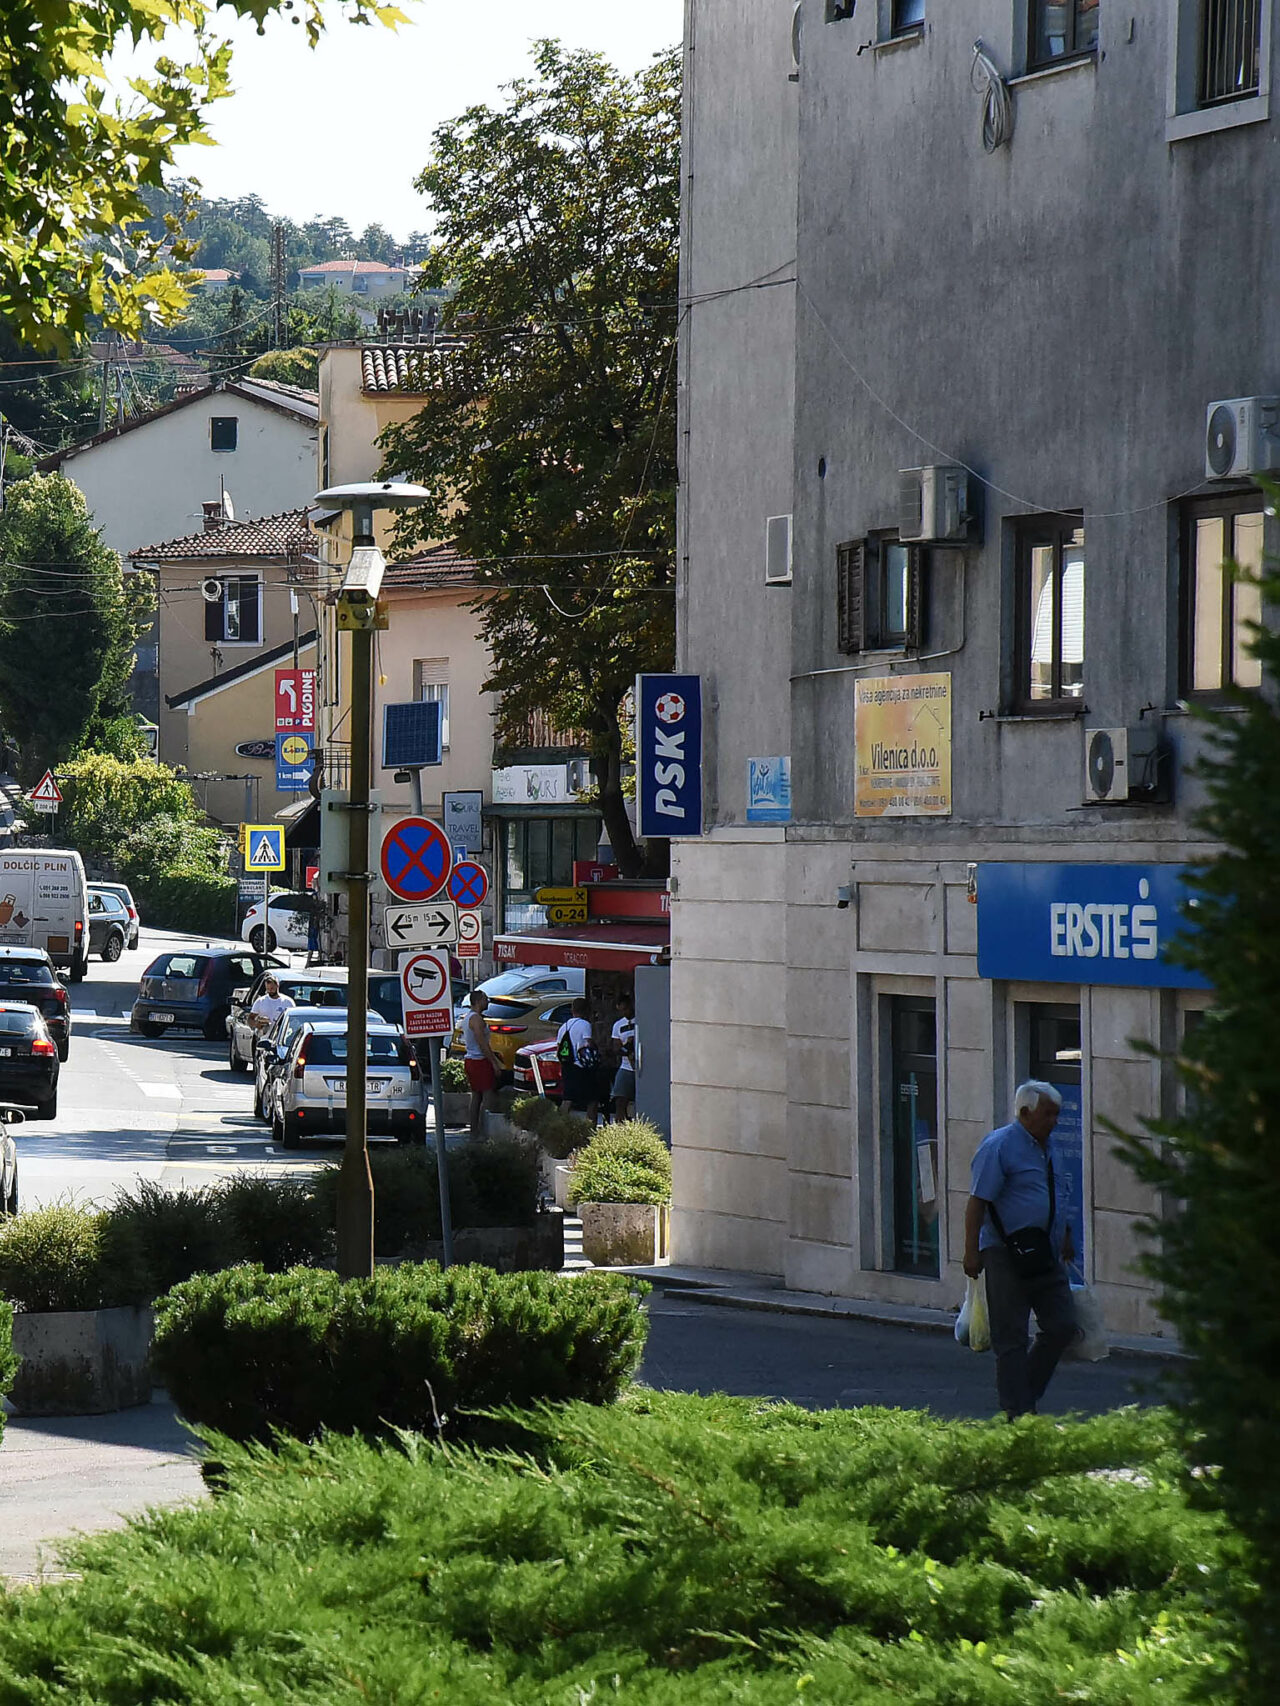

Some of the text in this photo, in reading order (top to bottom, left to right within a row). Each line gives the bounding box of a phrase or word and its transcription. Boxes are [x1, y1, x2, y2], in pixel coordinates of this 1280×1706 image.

[302, 671, 313, 727] PLODINE
[871, 740, 939, 770] Vilenica d.o.o.
[655, 726, 685, 818] PSK
[448, 824, 480, 833] TRAVEL
[44, 863, 67, 871] PLIN
[423, 913, 431, 921] 15
[555, 909, 585, 919] 0-24
[1050, 903, 1130, 958] ERSTE
[497, 944, 517, 958] TISAK
[393, 1086, 403, 1094] HR
